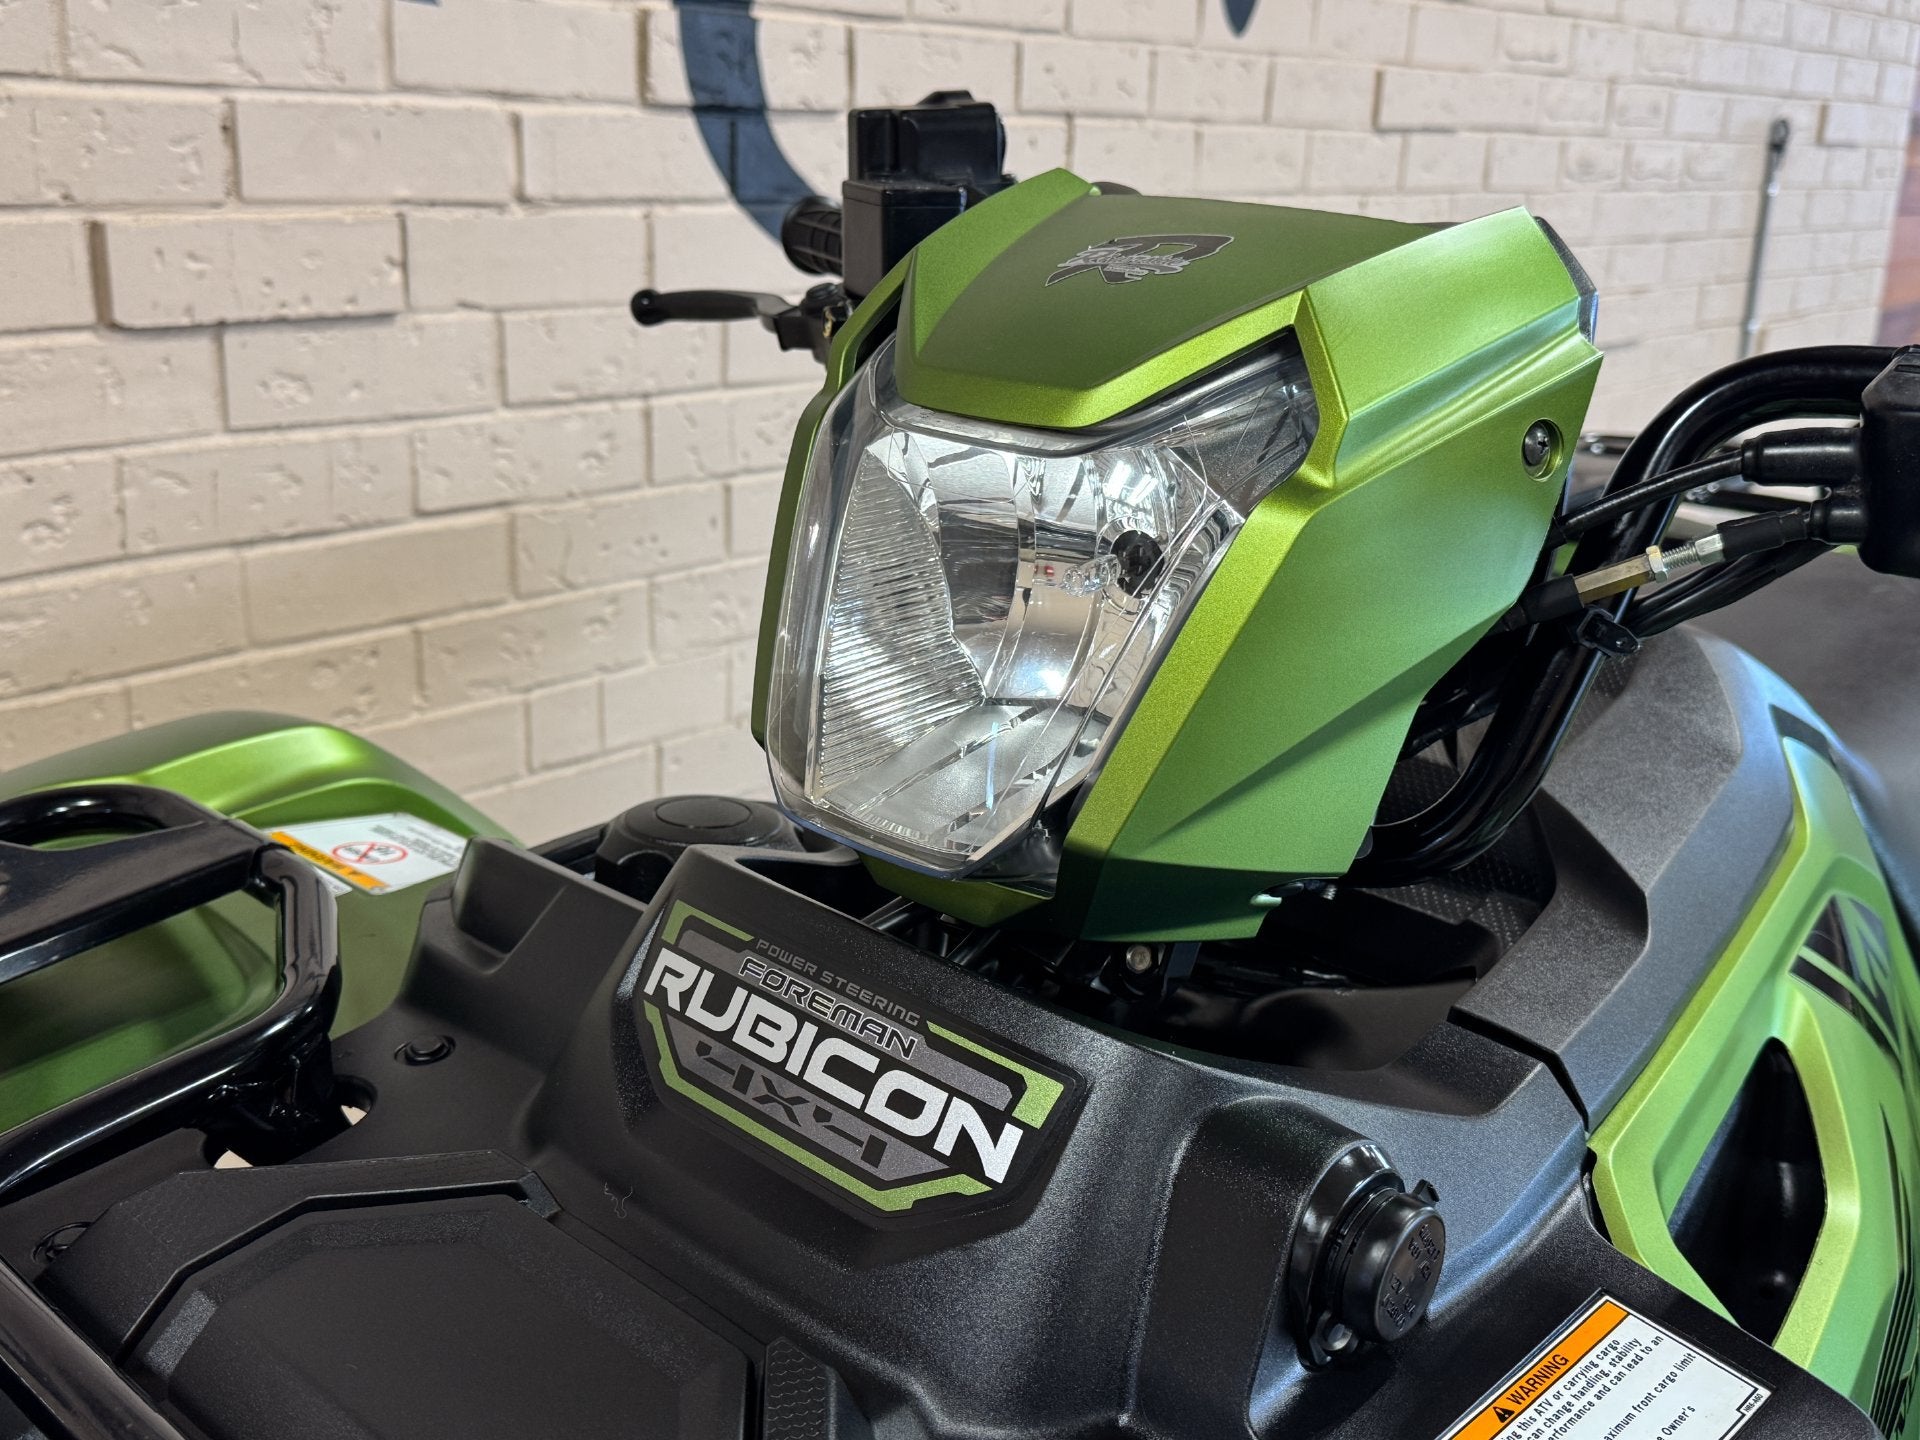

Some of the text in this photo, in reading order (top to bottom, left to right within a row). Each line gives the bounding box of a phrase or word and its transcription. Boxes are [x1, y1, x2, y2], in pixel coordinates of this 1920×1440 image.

[738, 956, 919, 1061] FOREMAN
[756, 938, 921, 1027] POWER STEERING
[643, 947, 1024, 1185] RUBICON
[1506, 1353, 1570, 1406] WARNING
[1517, 1414, 1537, 1431] this
[1533, 1398, 1554, 1417] ATV
[1552, 1390, 1564, 1401] or
[1563, 1359, 1600, 1391] carrying
[1596, 1339, 1621, 1361] cargo
[1543, 1400, 1575, 1429] change
[1572, 1367, 1612, 1402] handling,
[1608, 1337, 1643, 1368] stability
[1593, 1384, 1611, 1401] and
[1609, 1371, 1627, 1386] can
[1621, 1353, 1644, 1372] lead
[1641, 1345, 1653, 1355] to
[1650, 1334, 1664, 1349] an
[1632, 1391, 1657, 1413] front
[1654, 1370, 1678, 1394] cargo
[1673, 1352, 1697, 1372] limit
[1661, 1404, 1696, 1436] Owner's
